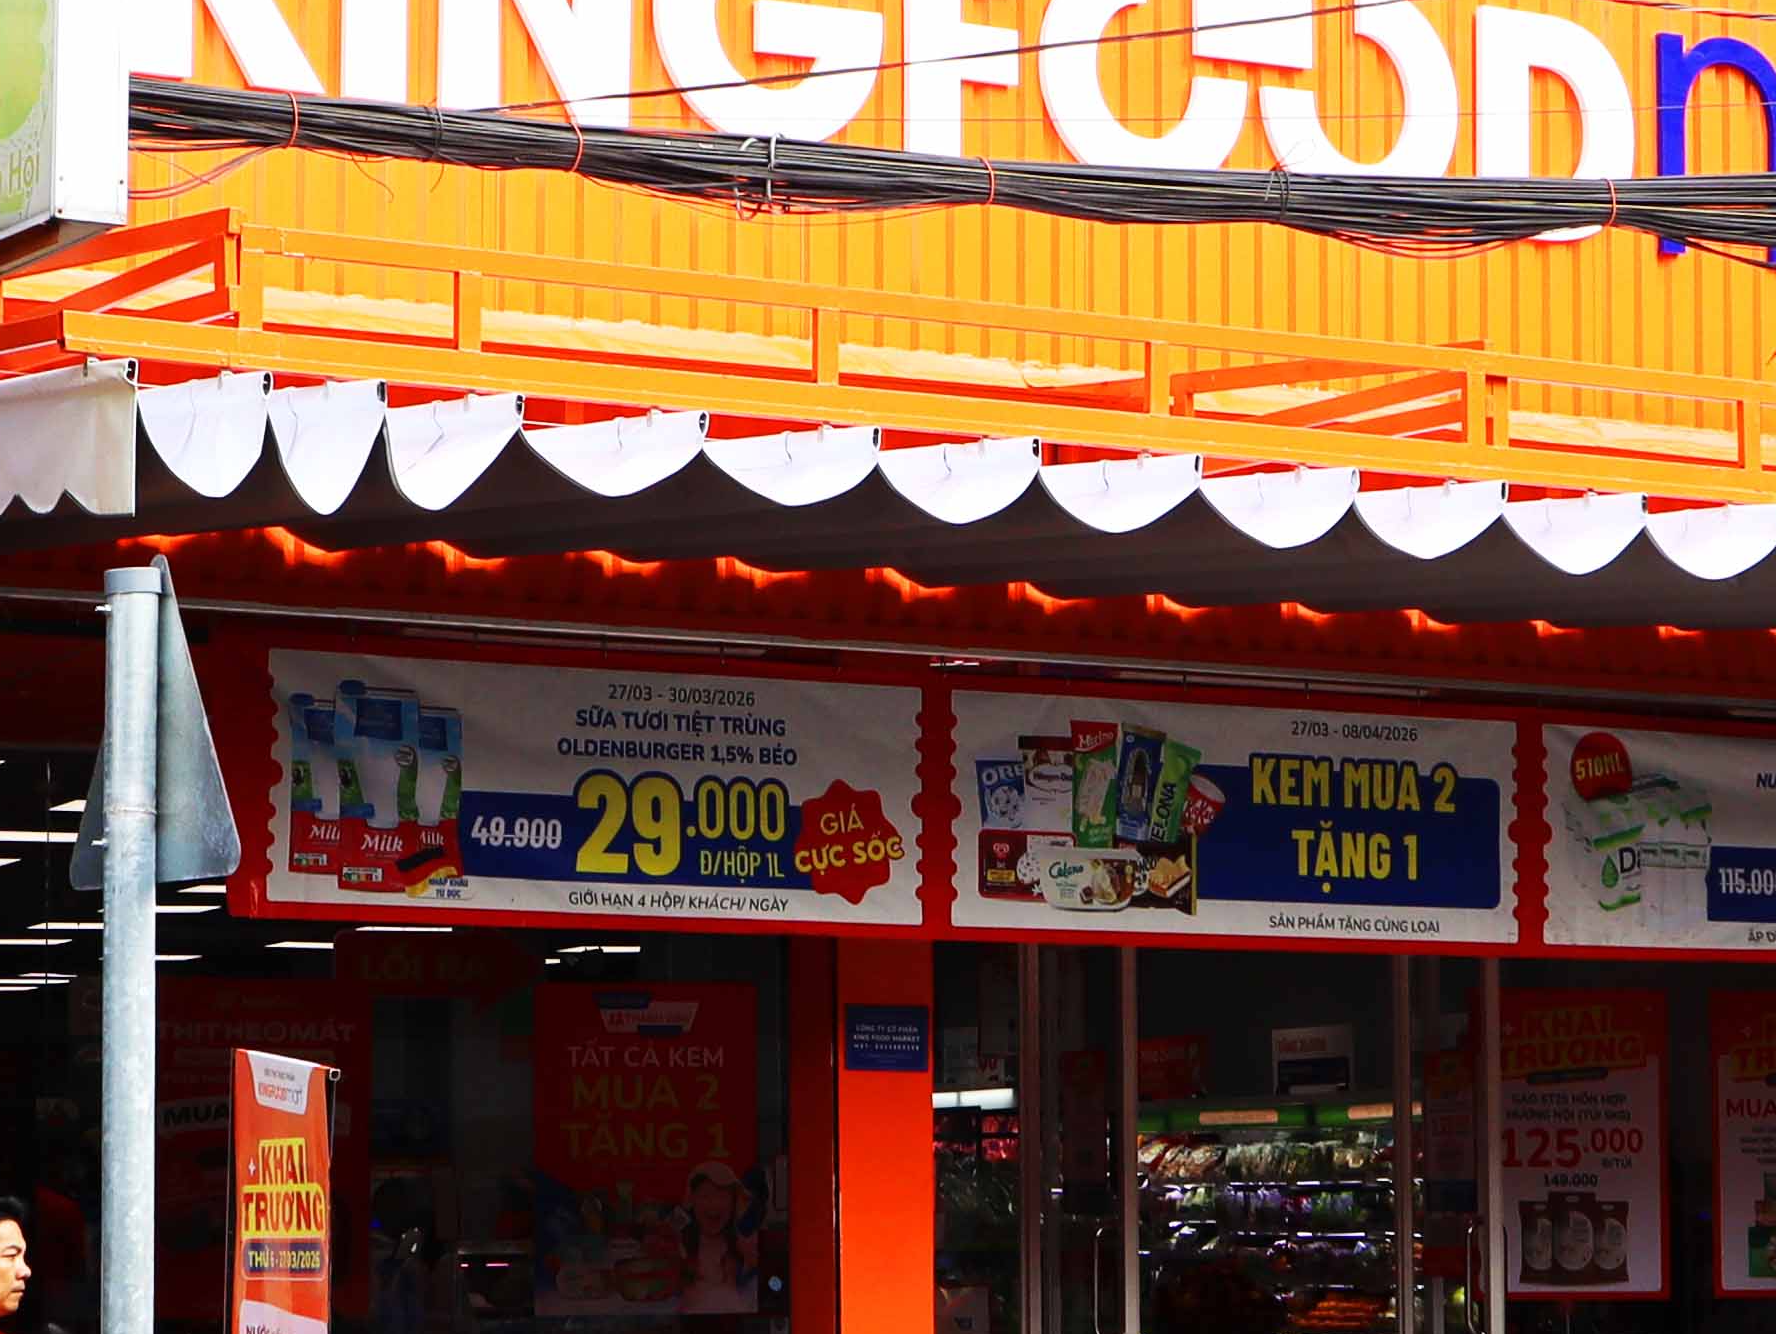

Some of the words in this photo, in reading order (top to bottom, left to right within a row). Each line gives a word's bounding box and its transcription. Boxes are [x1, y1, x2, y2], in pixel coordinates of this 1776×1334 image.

[608, 684, 651, 705] 27/03
[668, 685, 756, 708] 30/03/2026
[575, 707, 618, 732] SỮA
[621, 711, 672, 734] TƯƠI
[674, 709, 718, 737] TIỆT
[722, 711, 786, 737] TRÙNG
[1291, 721, 1329, 738] 27/03
[1341, 724, 1418, 743] 08/04/2026
[557, 737, 706, 763] OLDENBURGER
[758, 739, 797, 766] BÉO
[1574, 751, 1624, 782] 510ML
[1252, 758, 1328, 808] KEM
[1343, 758, 1421, 812] MUA
[1434, 766, 1457, 814] 2
[308, 821, 340, 843] Mil
[471, 815, 563, 848] 49.900
[576, 772, 786, 877] 29.000
[820, 804, 865, 835] GIÁ
[361, 831, 404, 854] Milk
[795, 841, 847, 875] CỰC
[852, 830, 904, 864] SỐC
[1291, 821, 1392, 895] TẶNG
[1401, 834, 1418, 881] 1
[699, 848, 763, 883] Đ/HỘP
[766, 851, 785, 878] 1L
[568, 887, 598, 908] GIỚI
[601, 889, 634, 912] HẠN
[637, 894, 647, 909] 4
[689, 889, 746, 913] KHÁCH/
[749, 892, 789, 914] NGÀY
[1269, 913, 1296, 931] SẢN
[1298, 912, 1336, 933] PHẨM
[1338, 914, 1371, 937] TẶNG
[1373, 914, 1408, 934] CÙNG
[1411, 918, 1440, 937] LOẠI
[1748, 928, 1764, 945] ÁP
[668, 1046, 725, 1068] KEM
[570, 1074, 680, 1111] MUA
[694, 1074, 722, 1111] 2
[1726, 1099, 1776, 1118] MUA
[704, 1123, 732, 1159] 1
[262, 1143, 305, 1185] KHAI
[243, 1187, 325, 1233] TRƯƠNG
